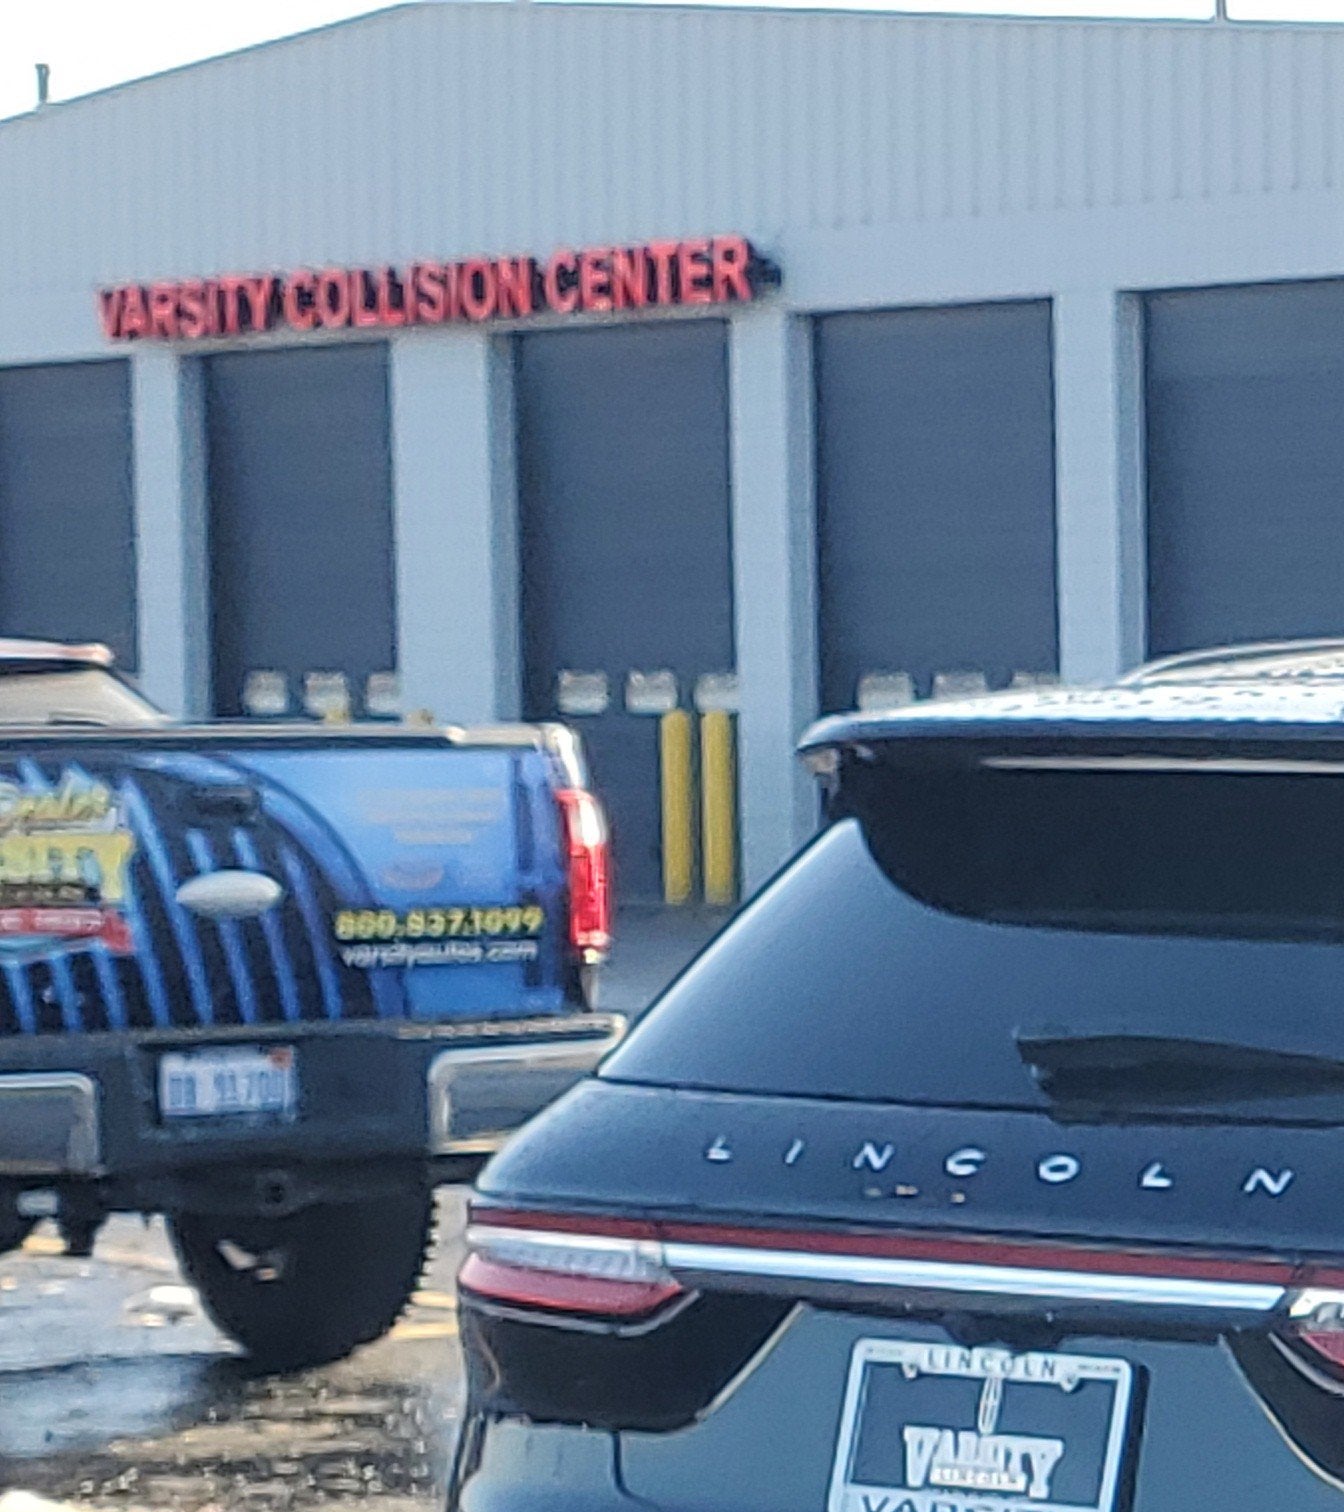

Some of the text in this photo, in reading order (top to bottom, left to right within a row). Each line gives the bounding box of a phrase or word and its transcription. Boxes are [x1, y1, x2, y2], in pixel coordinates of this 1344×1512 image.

[97, 235, 753, 338] VARSITY COLLISION CENTER
[706, 1135, 1295, 1194] LINCOLN
[927, 1348, 1057, 1378] LINCOLN
